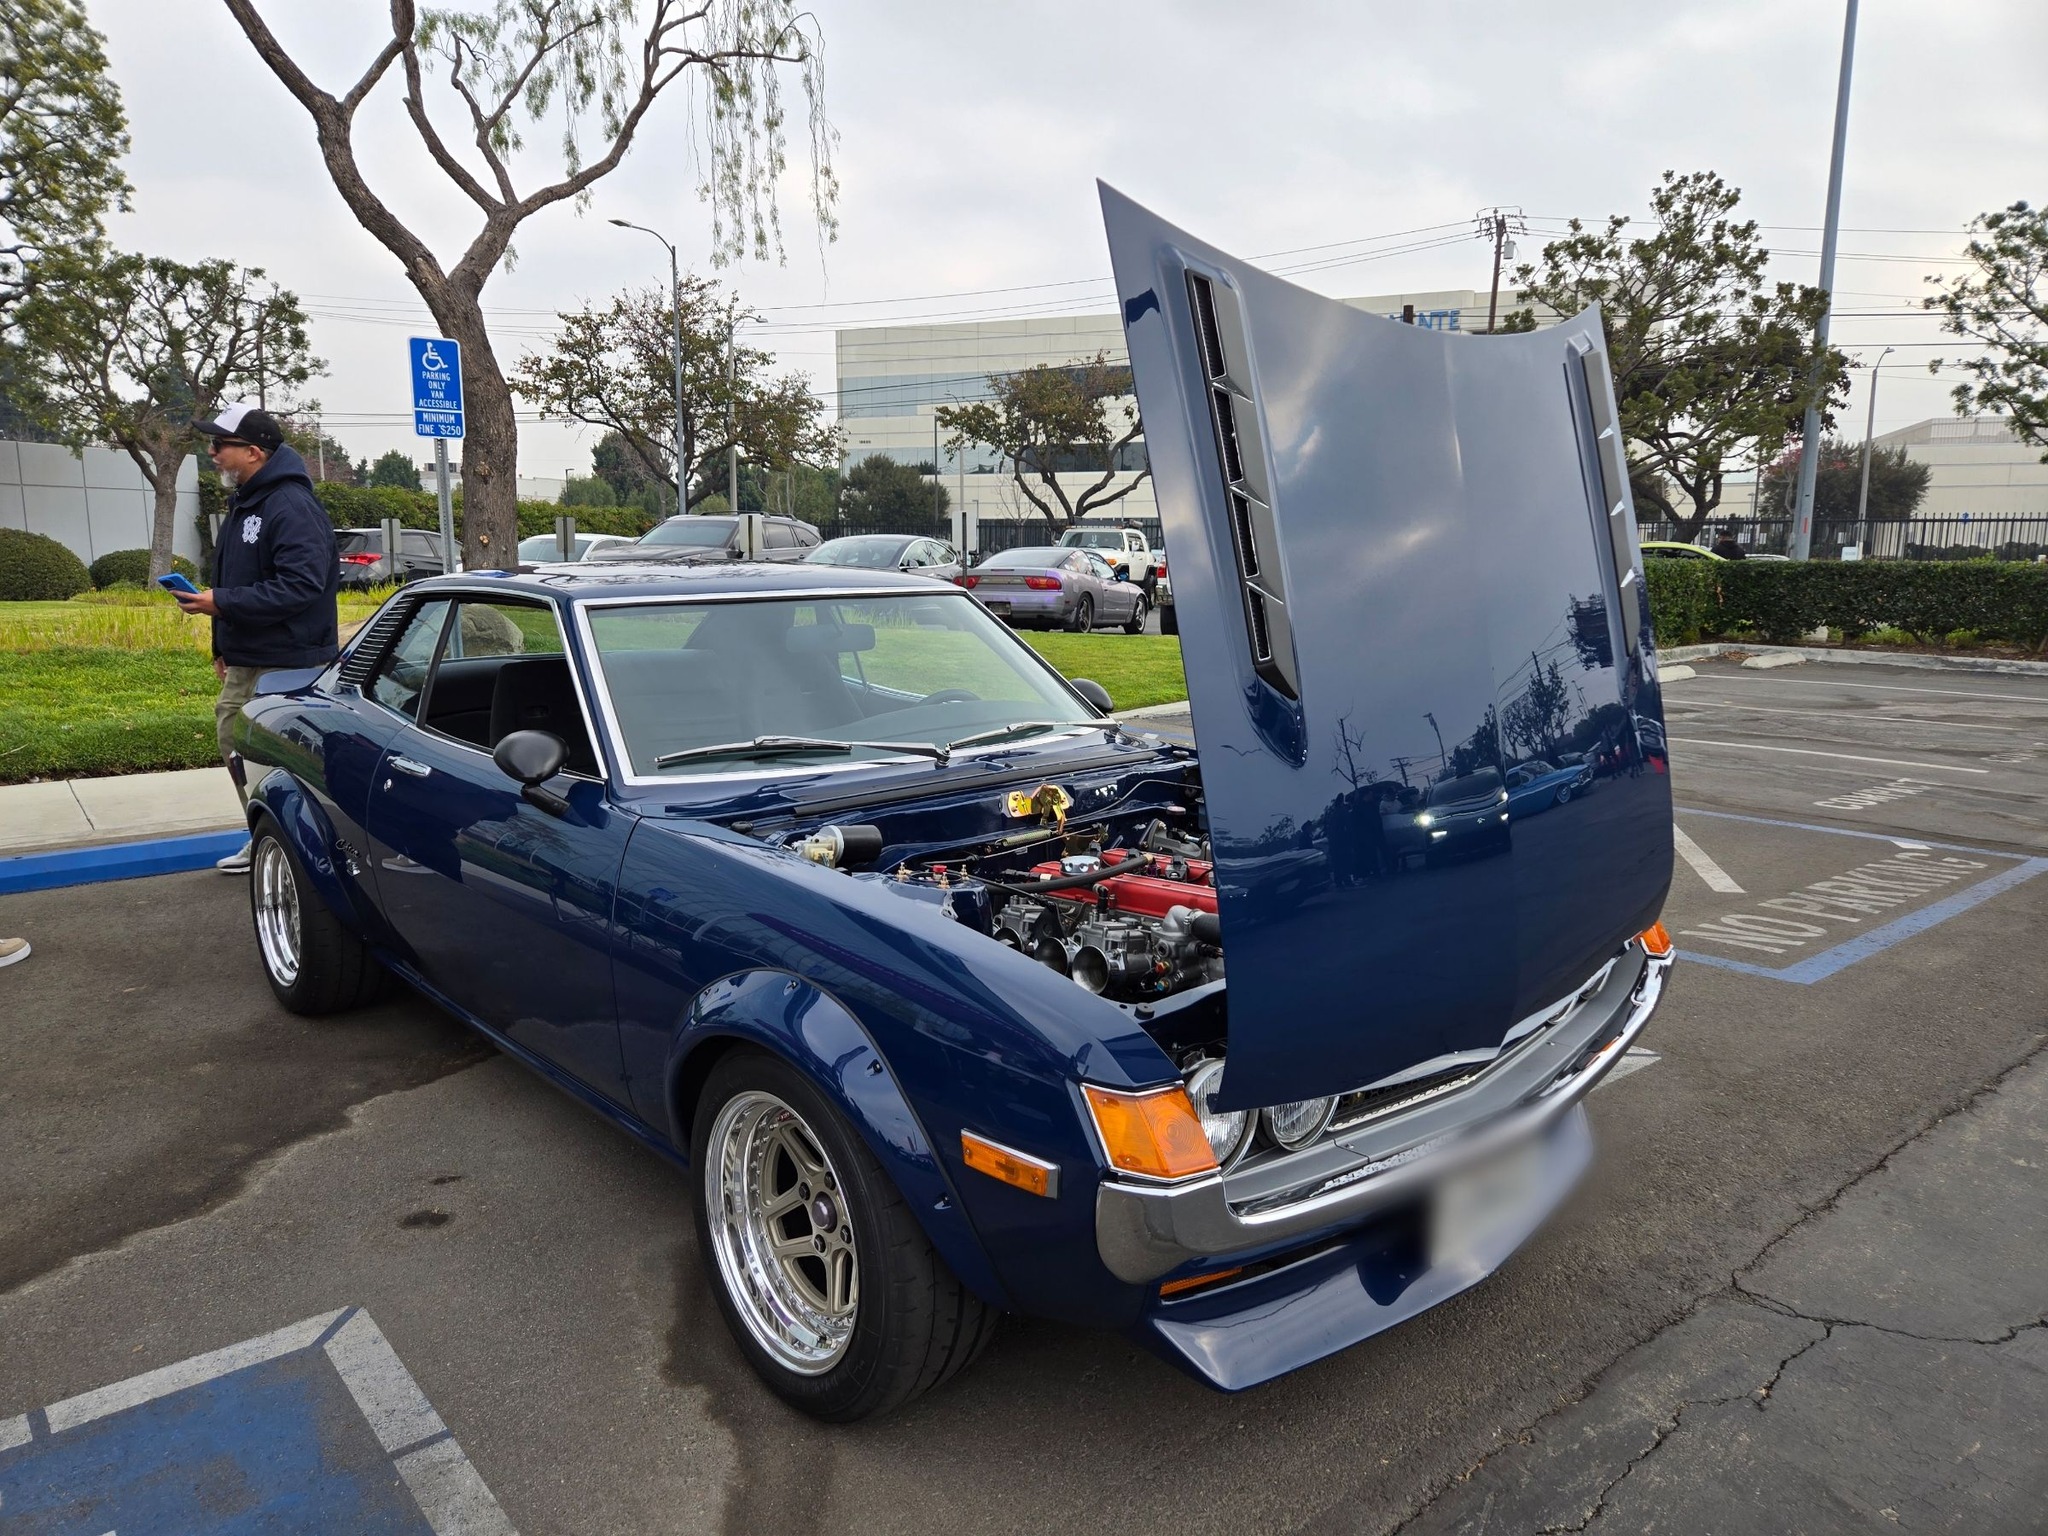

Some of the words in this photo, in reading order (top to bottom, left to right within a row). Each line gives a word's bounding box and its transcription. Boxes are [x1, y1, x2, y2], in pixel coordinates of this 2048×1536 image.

[1389, 309, 1460, 330] NTE
[422, 371, 450, 381] PARKING
[428, 380, 445, 390] ONLY
[431, 390, 444, 399] VAN
[419, 398, 457, 409] ACCESSIBLE
[423, 412, 455, 424] MINIMUM
[418, 424, 435, 435] FINE
[438, 424, 461, 435] $250
[1813, 778, 1944, 809] COMPACT
[1678, 914, 1828, 954] NO
[1757, 851, 1988, 923] PARKING
